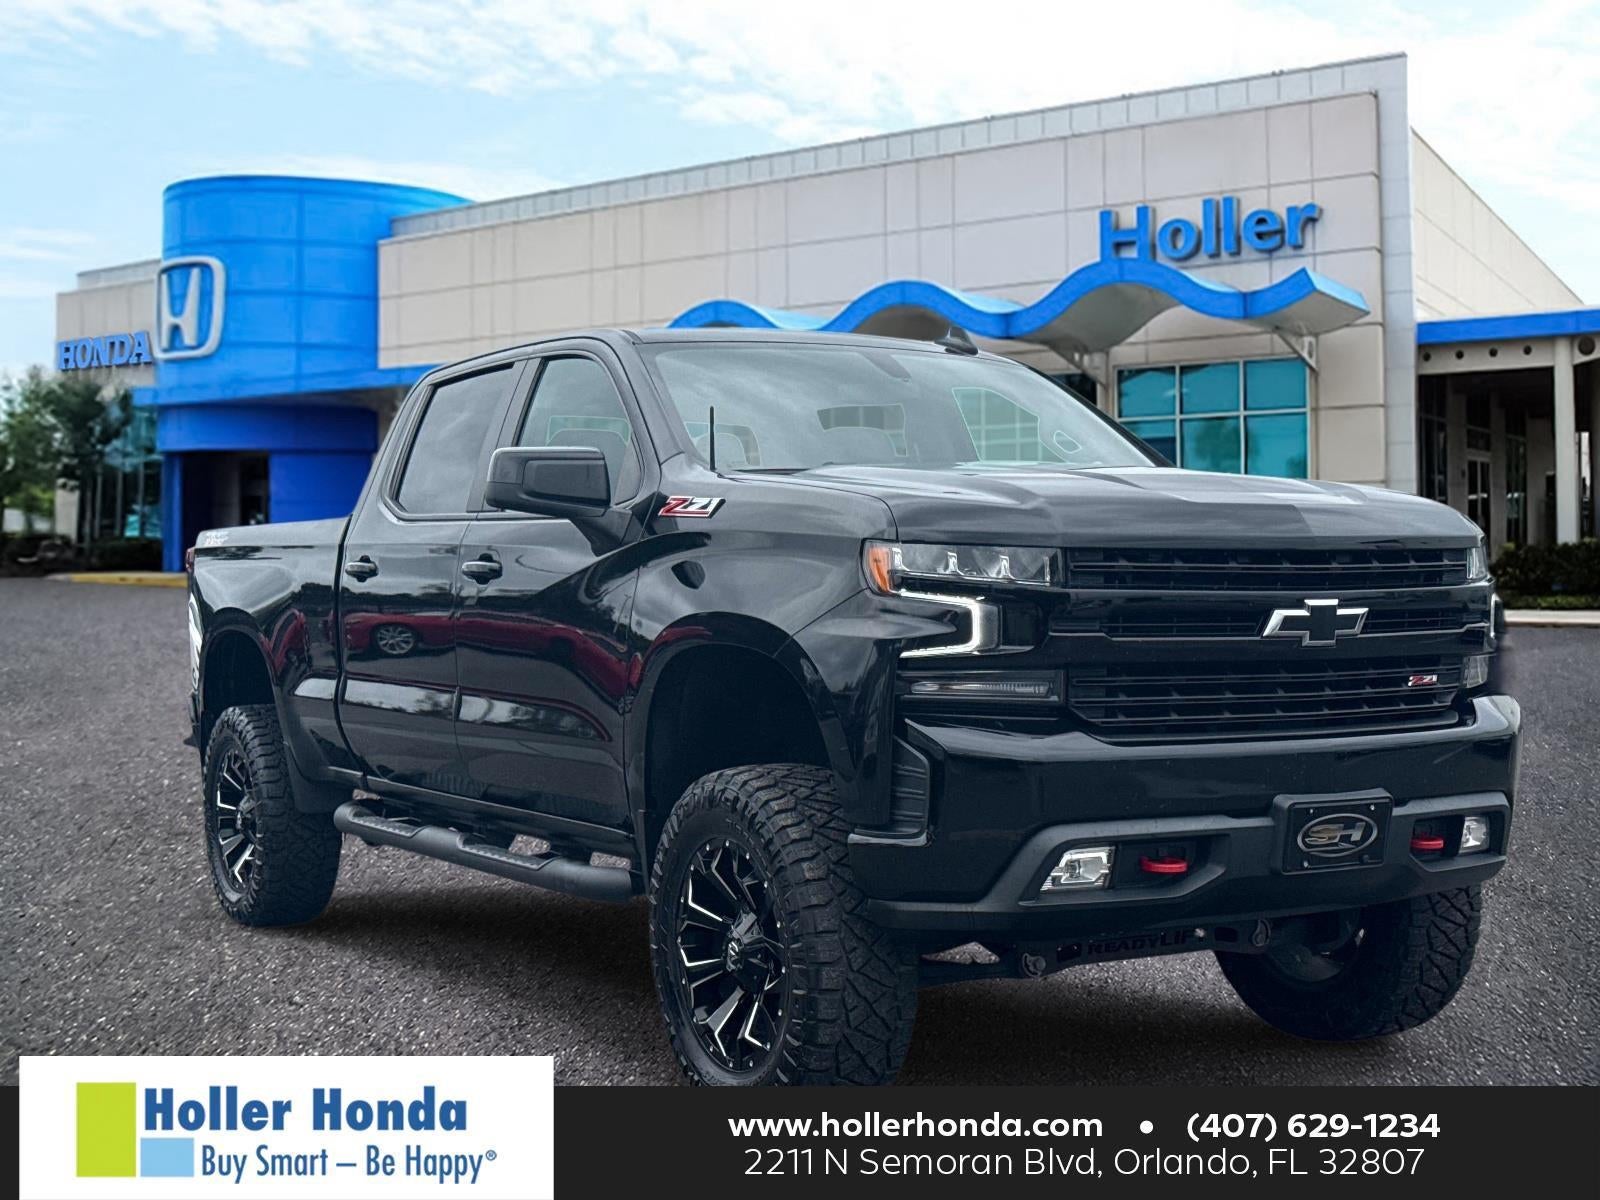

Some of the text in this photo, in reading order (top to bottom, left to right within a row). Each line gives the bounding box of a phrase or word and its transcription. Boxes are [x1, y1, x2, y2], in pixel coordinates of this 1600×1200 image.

[1100, 196, 1320, 260] Holler
[57, 331, 152, 370] HONDA
[658, 496, 723, 517] Z71
